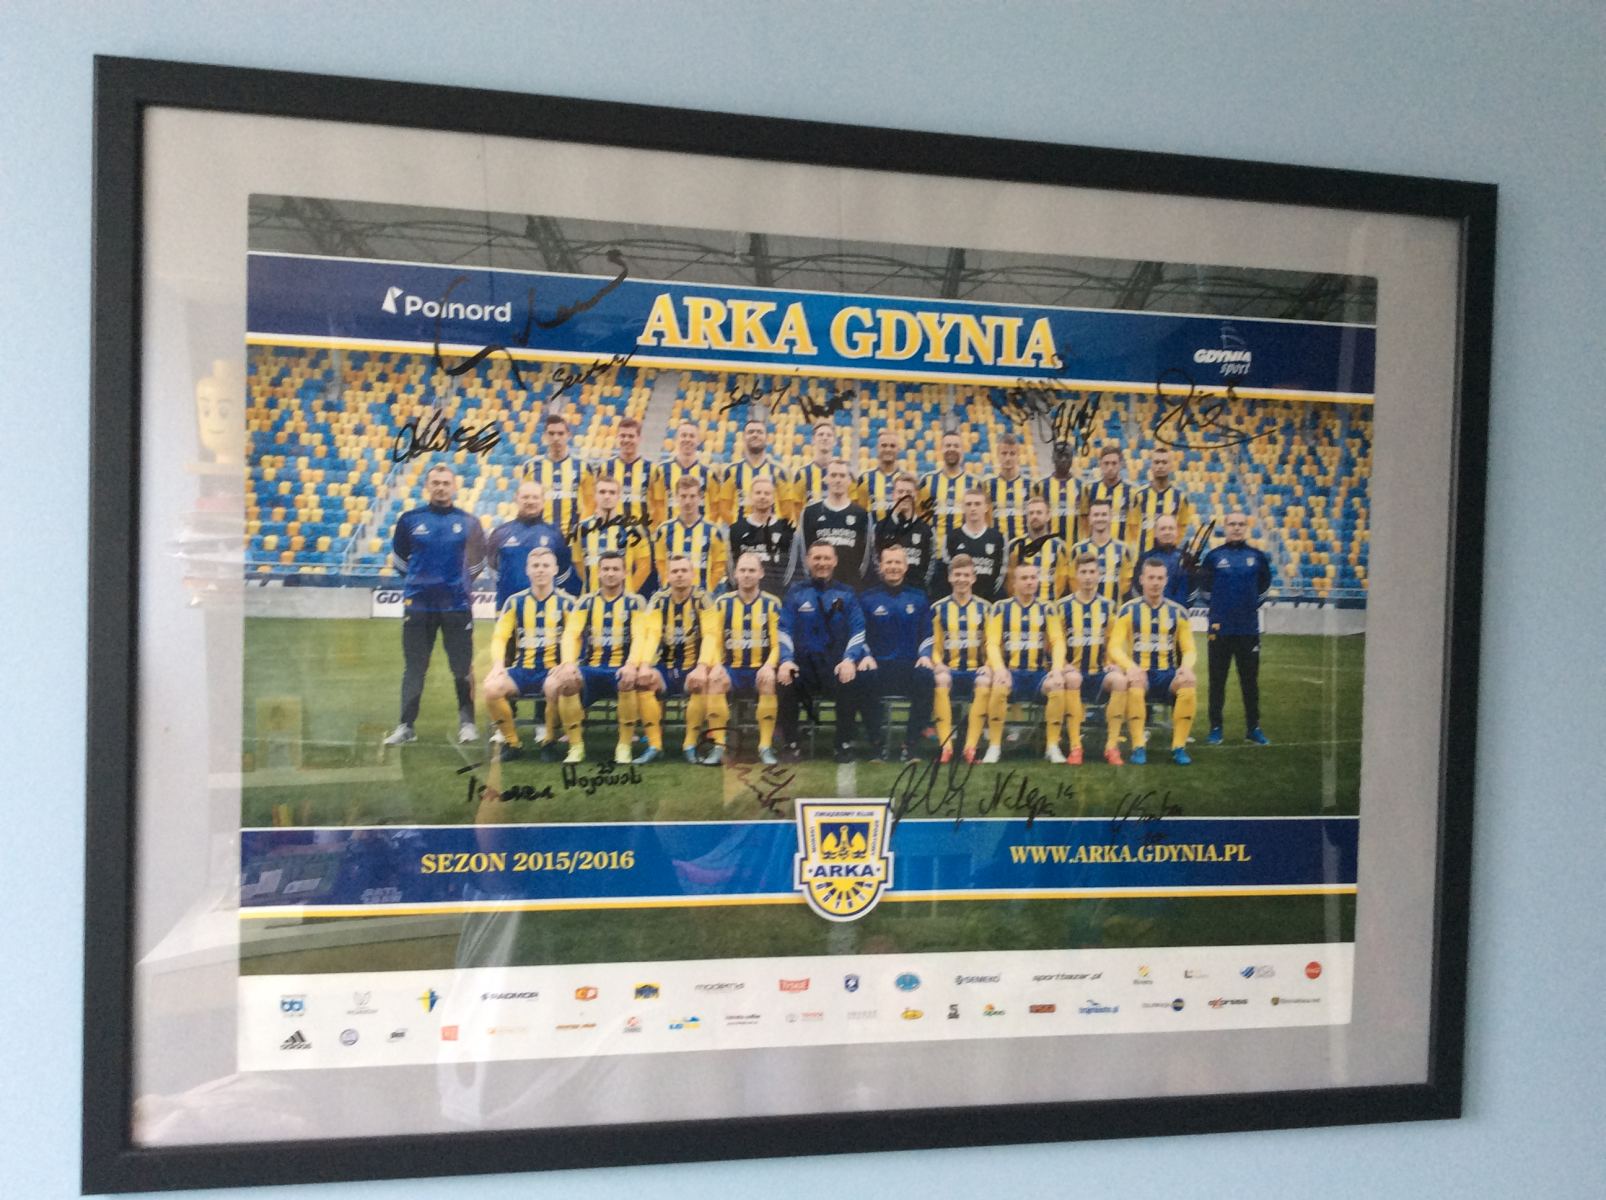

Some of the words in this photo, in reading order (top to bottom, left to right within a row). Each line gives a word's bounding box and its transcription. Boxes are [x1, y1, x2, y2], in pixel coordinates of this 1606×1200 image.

[637, 293, 818, 355] ARKA
[830, 306, 1063, 370] GDYNIA
[1193, 349, 1252, 364] GDYNIA
[420, 852, 507, 875] SEZON
[512, 850, 636, 875] 2015/2016
[1009, 844, 1251, 865] WWW.ARKA.GDYNIA.PL
[813, 864, 874, 877] ARKA
